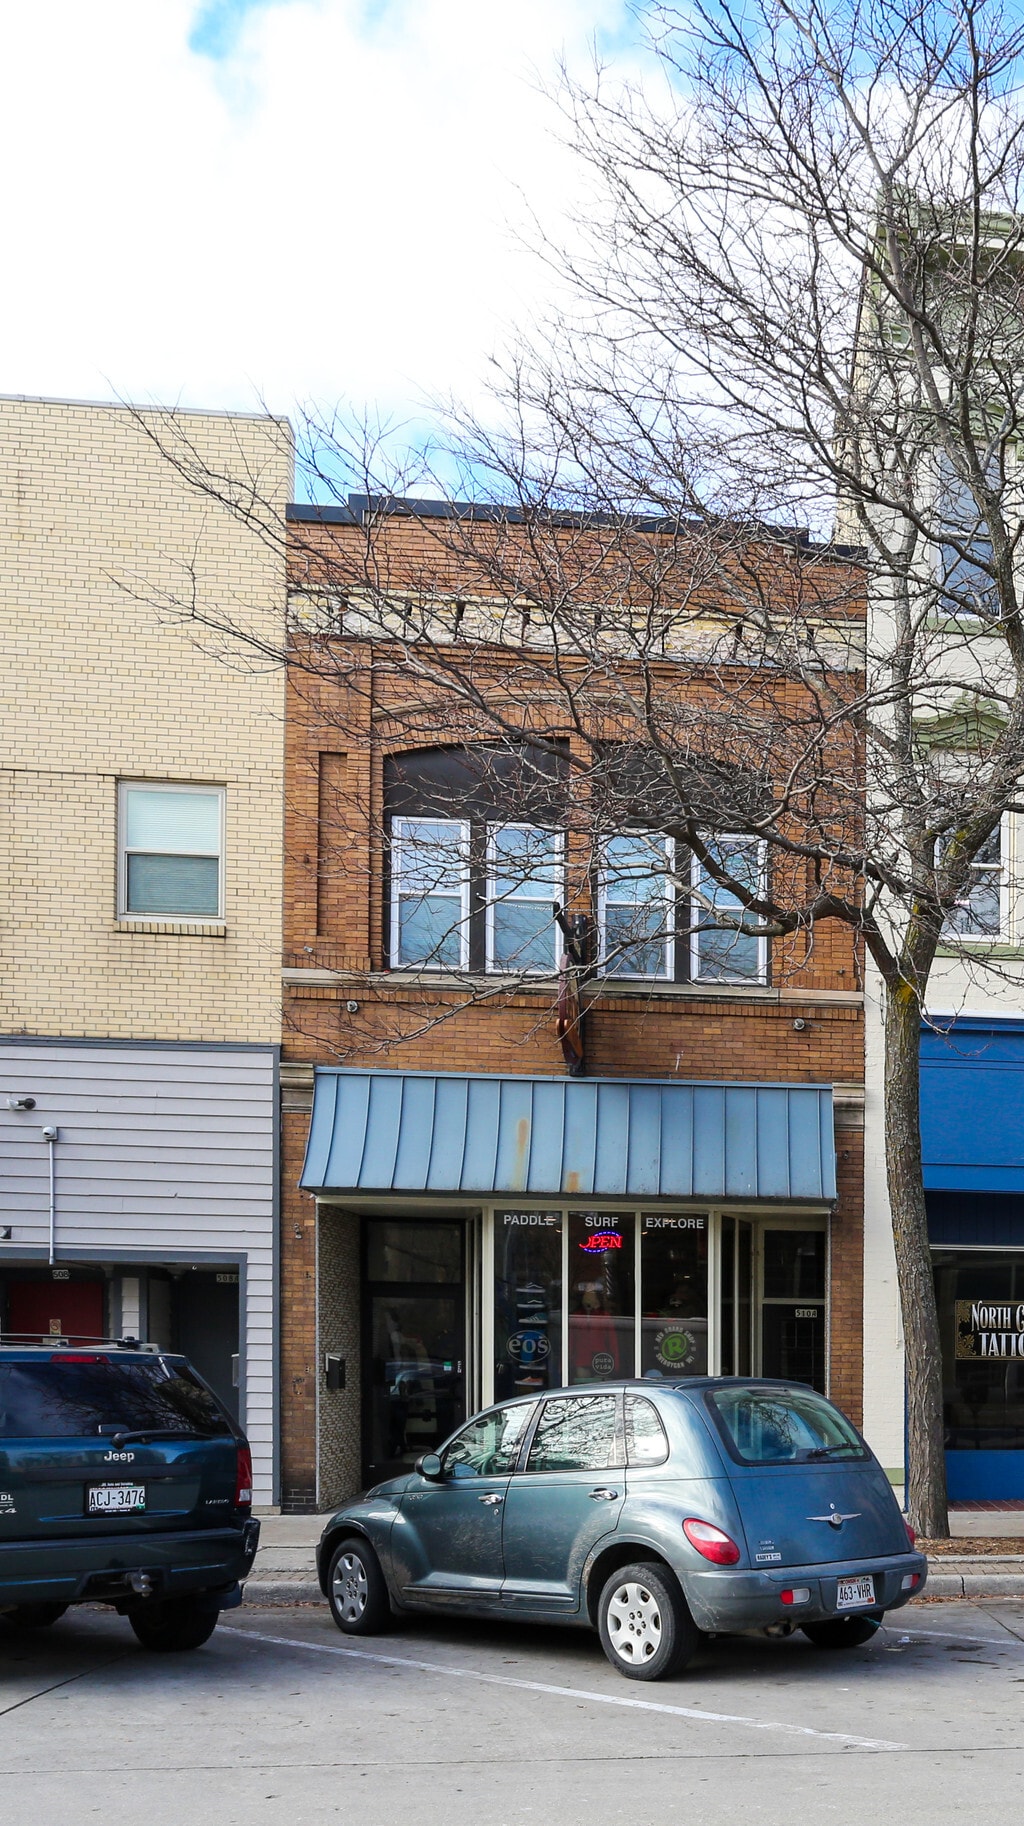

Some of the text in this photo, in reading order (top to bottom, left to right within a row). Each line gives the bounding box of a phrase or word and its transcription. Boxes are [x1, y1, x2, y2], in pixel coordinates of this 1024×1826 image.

[503, 1215, 554, 1225] PADDLE
[584, 1216, 619, 1227] SURF
[645, 1217, 705, 1229] EXPLORE
[507, 1338, 550, 1354] eos
[103, 1450, 135, 1463] Jeep
[89, 1490, 145, 1507] ACJ-3476
[840, 1584, 872, 1602] 463-VHR
